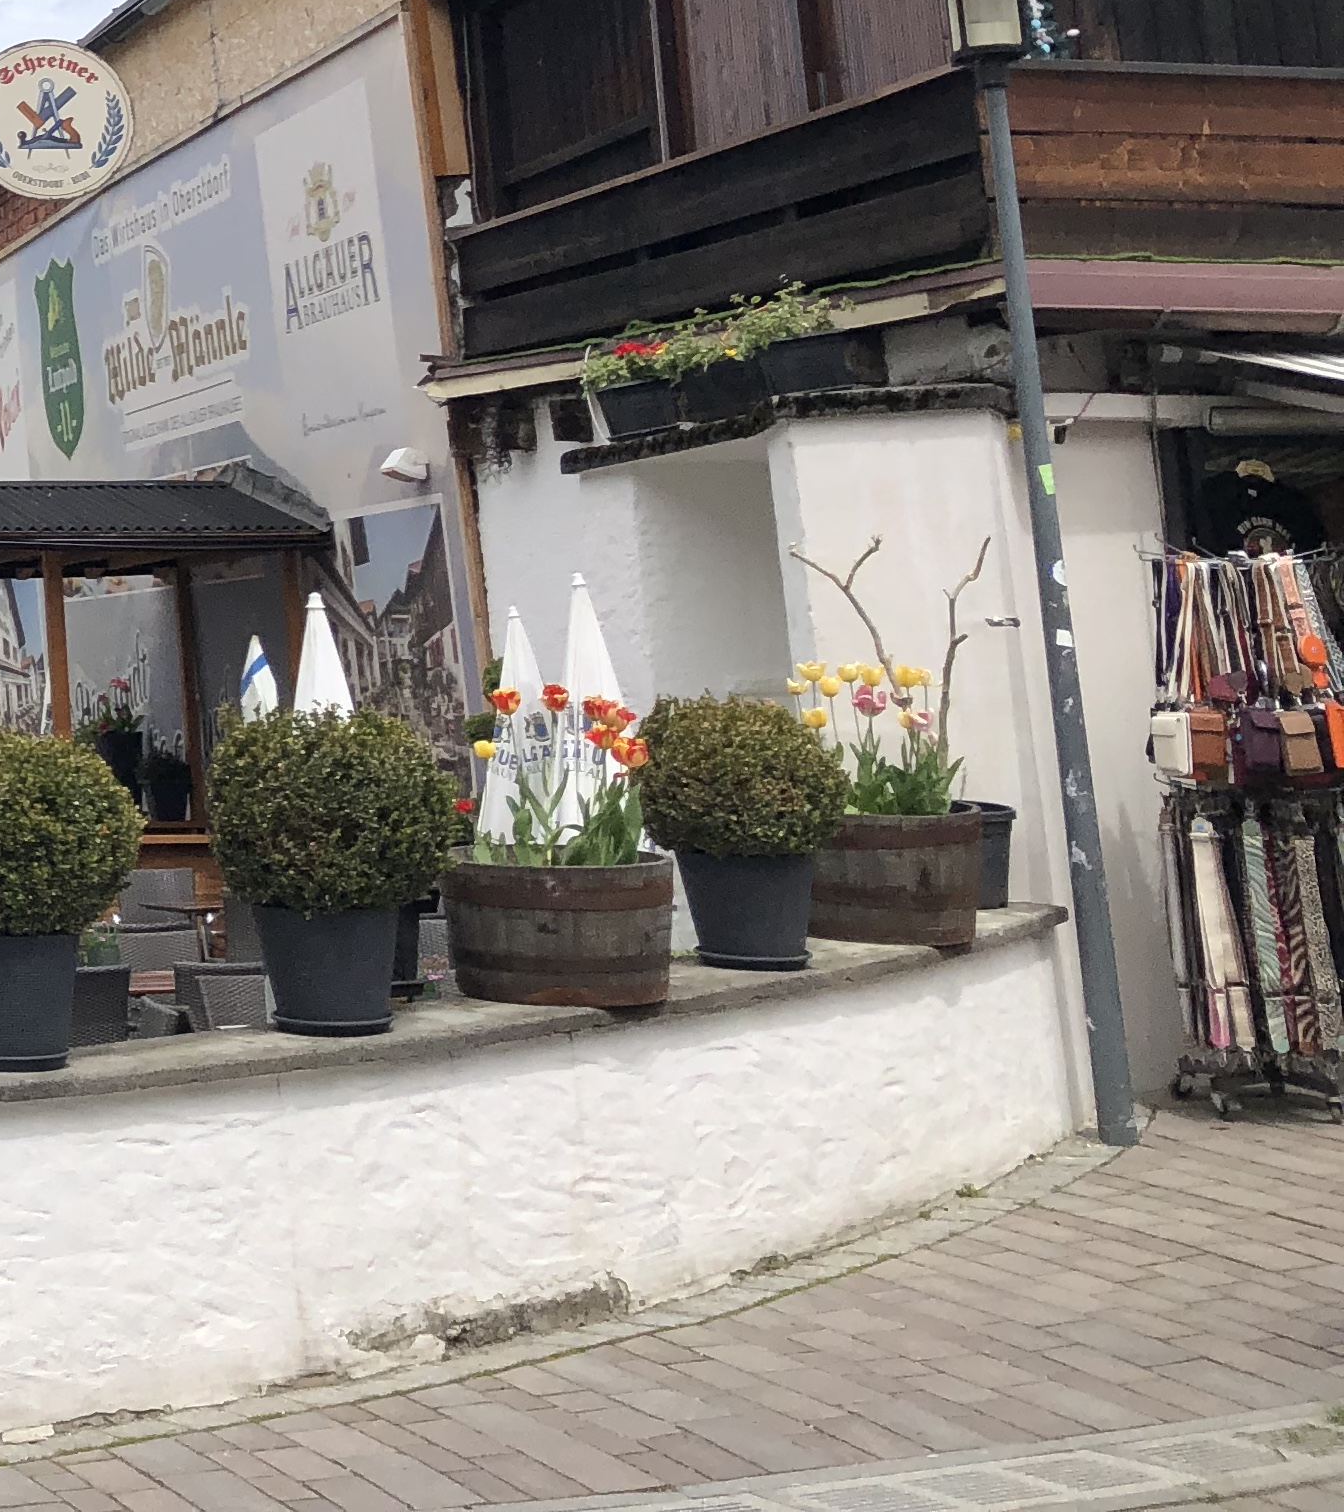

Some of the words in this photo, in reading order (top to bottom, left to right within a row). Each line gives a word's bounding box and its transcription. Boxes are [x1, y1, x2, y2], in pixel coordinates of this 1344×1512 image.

[12, 170, 64, 189] OBERSTDORF
[172, 162, 230, 218] Oberstdorf
[302, 285, 363, 327] BRAUHAUS
[104, 331, 156, 405] Wilde
[168, 295, 248, 383] Männle
